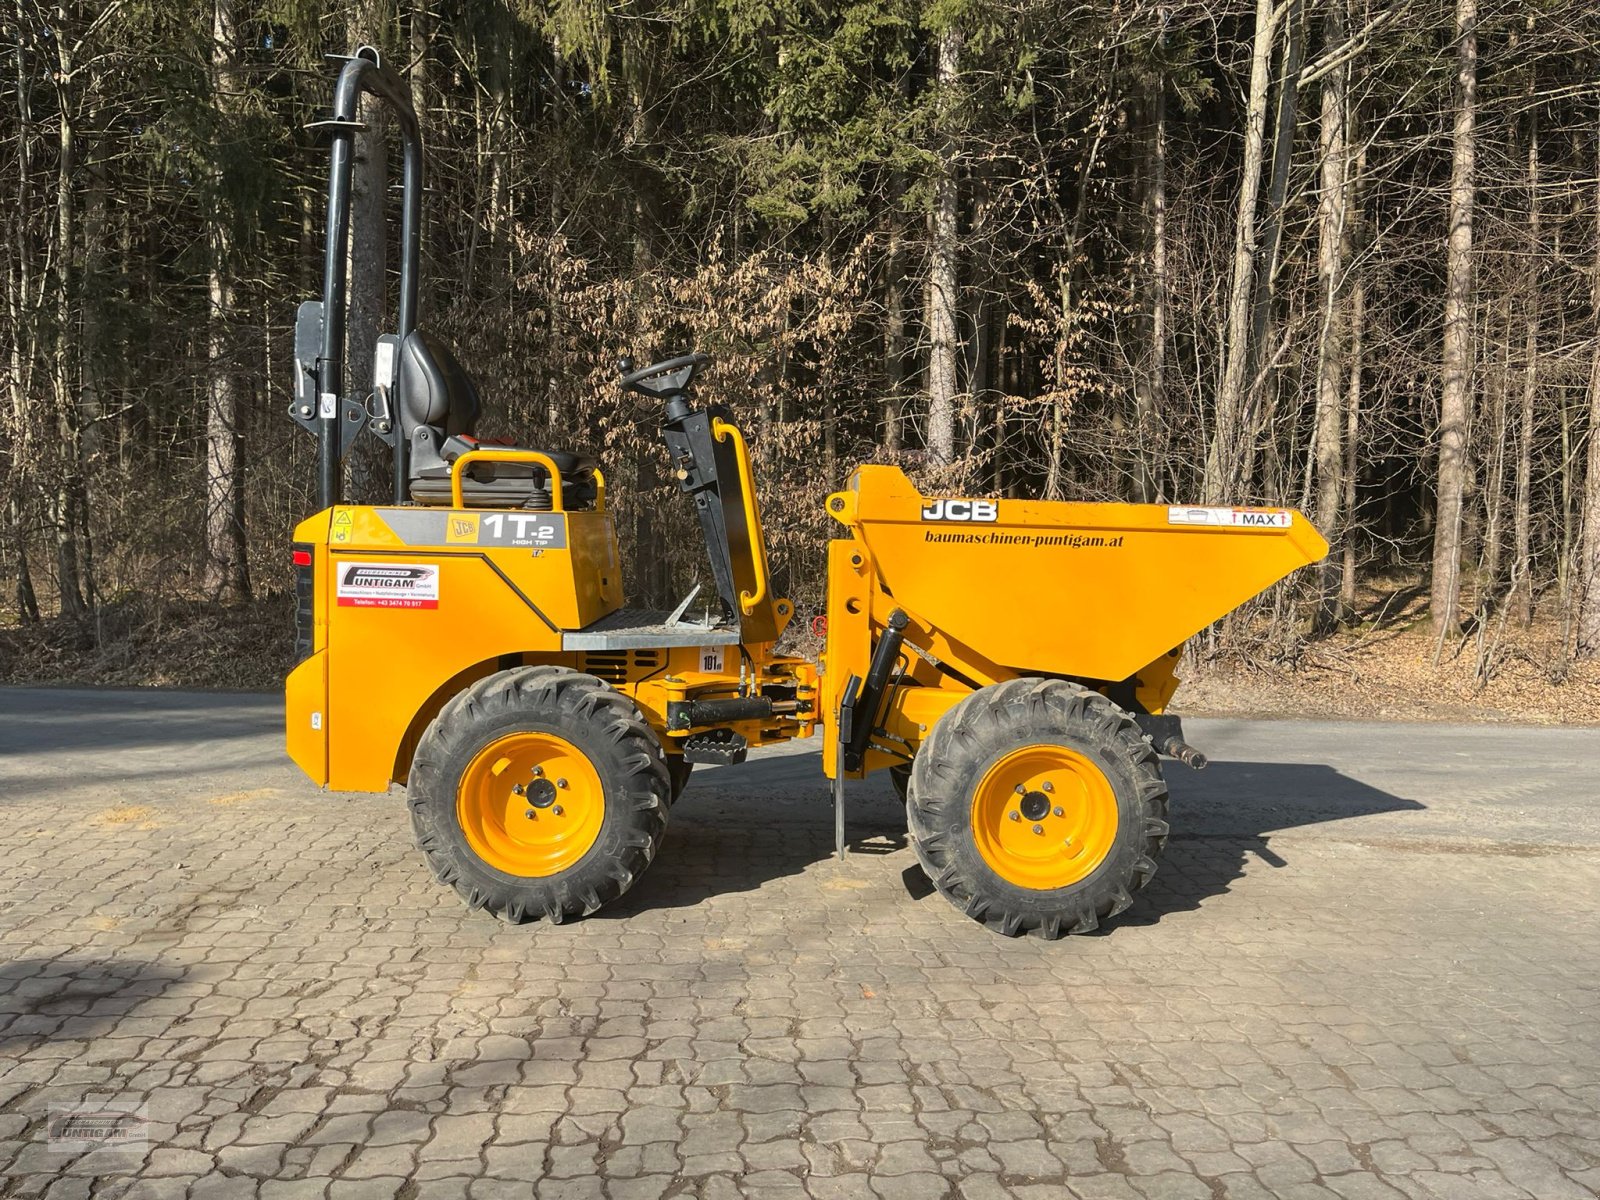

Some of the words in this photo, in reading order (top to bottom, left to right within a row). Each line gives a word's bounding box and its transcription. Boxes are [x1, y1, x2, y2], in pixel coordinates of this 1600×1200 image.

[923, 500, 998, 521] JCB
[1243, 514, 1275, 525] MAX
[455, 520, 474, 536] JCB
[925, 531, 1124, 549] baumaschinen-puntigam.at
[704, 655, 717, 670] 101
